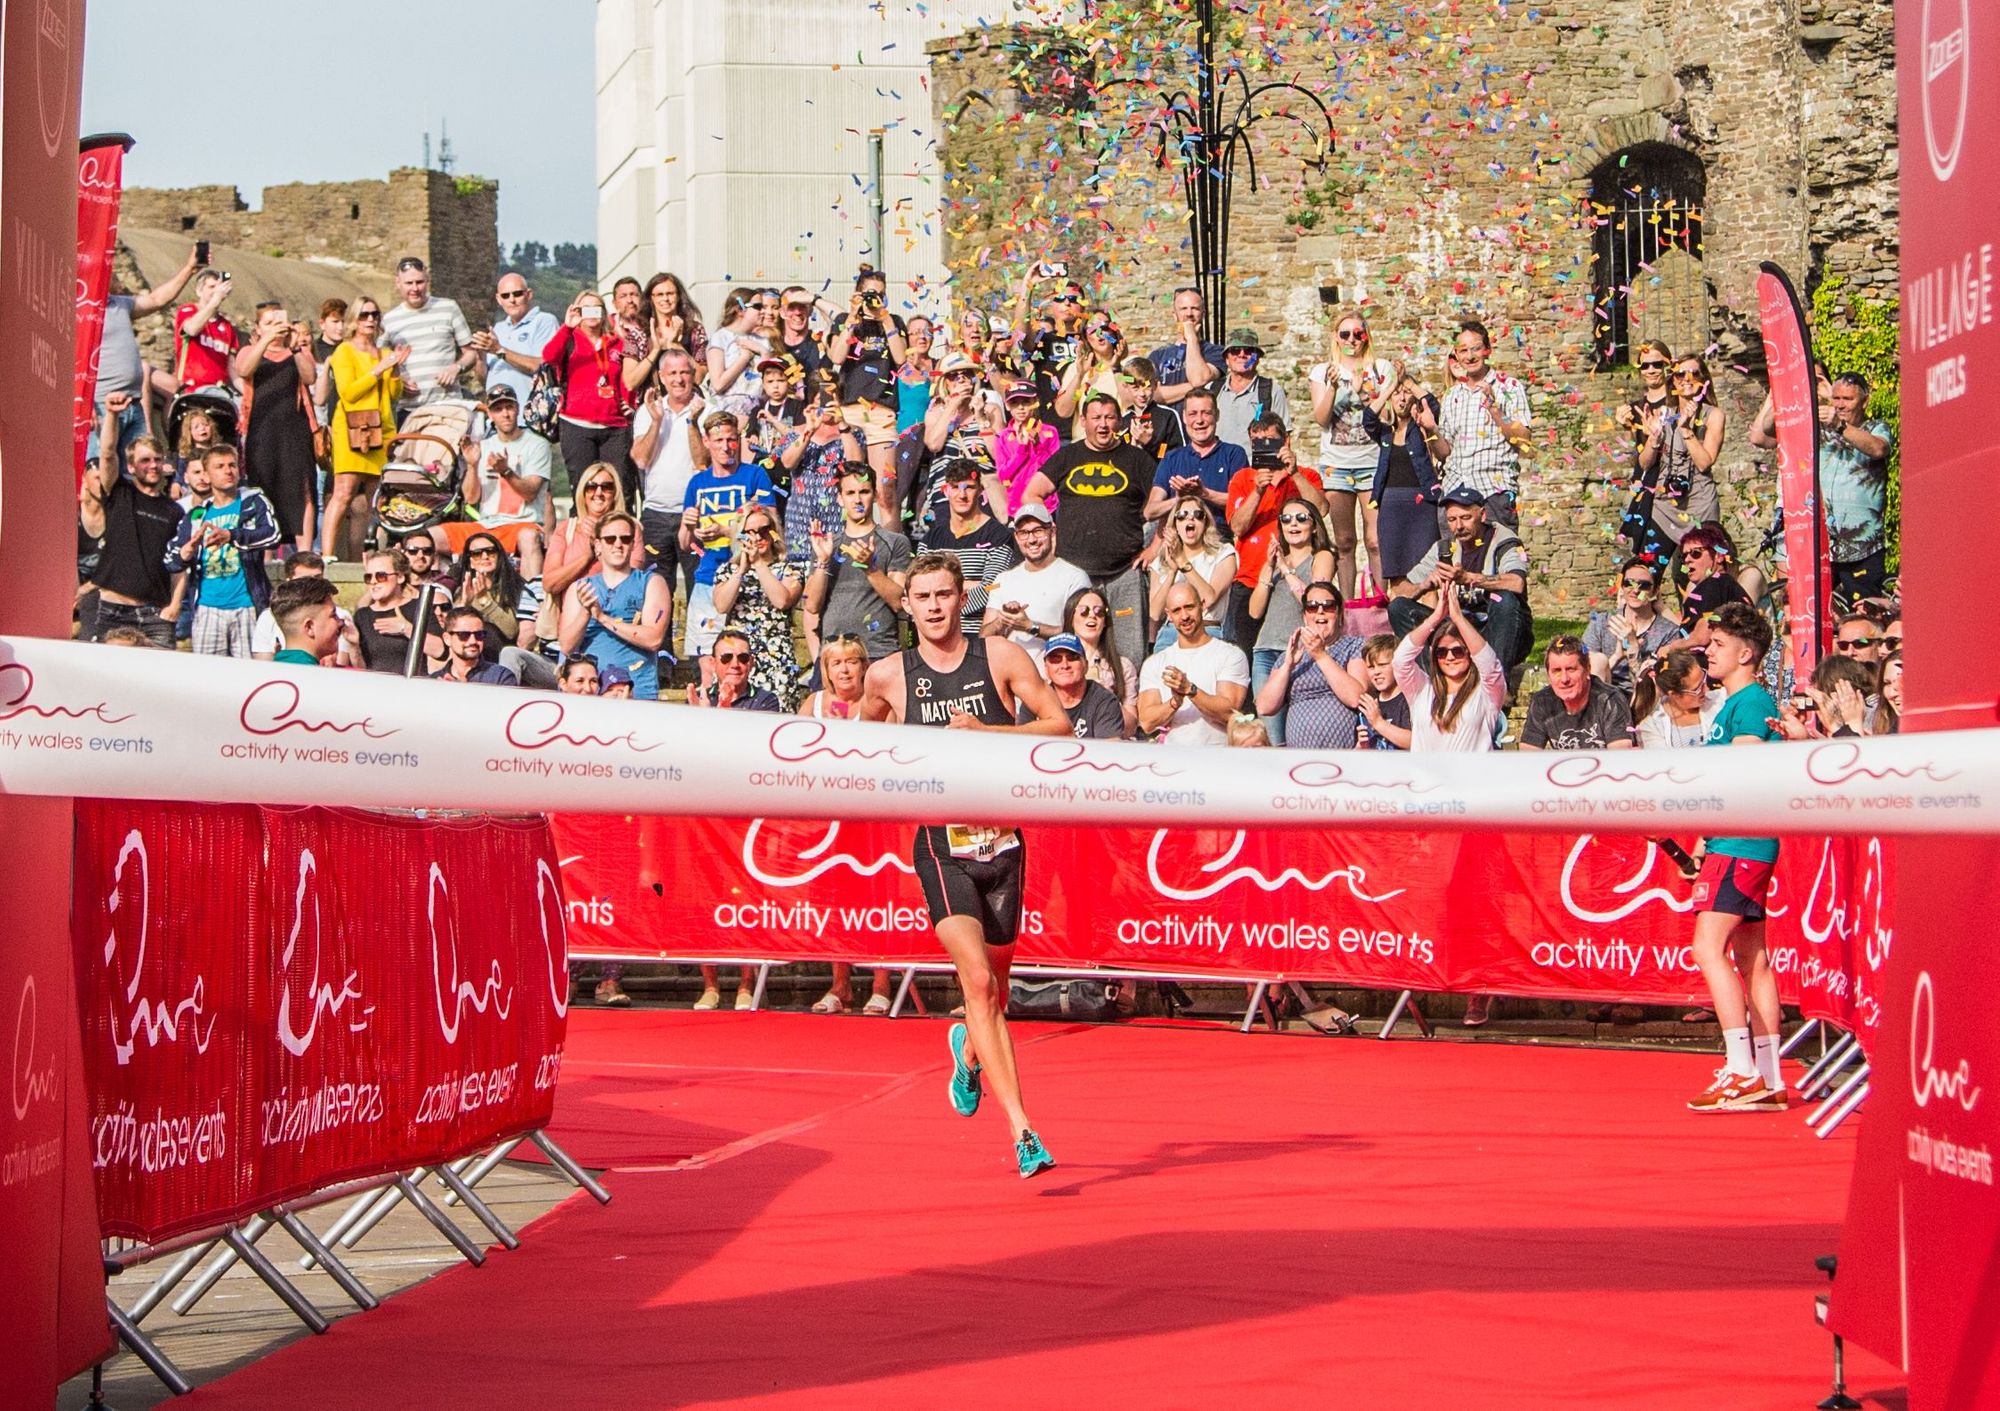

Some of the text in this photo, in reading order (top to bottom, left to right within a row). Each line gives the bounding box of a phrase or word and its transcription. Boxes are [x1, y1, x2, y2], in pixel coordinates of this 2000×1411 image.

[1908, 243, 1992, 353] VILLAGE
[1926, 354, 1966, 408] HOTELS
[28, 732, 83, 750] wales
[89, 736, 153, 754] events
[221, 742, 418, 767] activity wales events
[486, 757, 682, 781] activity wales events
[749, 770, 945, 794] activity wales events
[1011, 782, 1206, 806] activity wales events
[1272, 794, 1466, 815] activity wales events
[1531, 795, 1725, 815] activity wales events
[565, 897, 614, 926] nts
[714, 900, 928, 937] activity wales
[1117, 915, 1233, 952] activity
[1242, 918, 1330, 950] wales
[1531, 937, 1644, 976] activity
